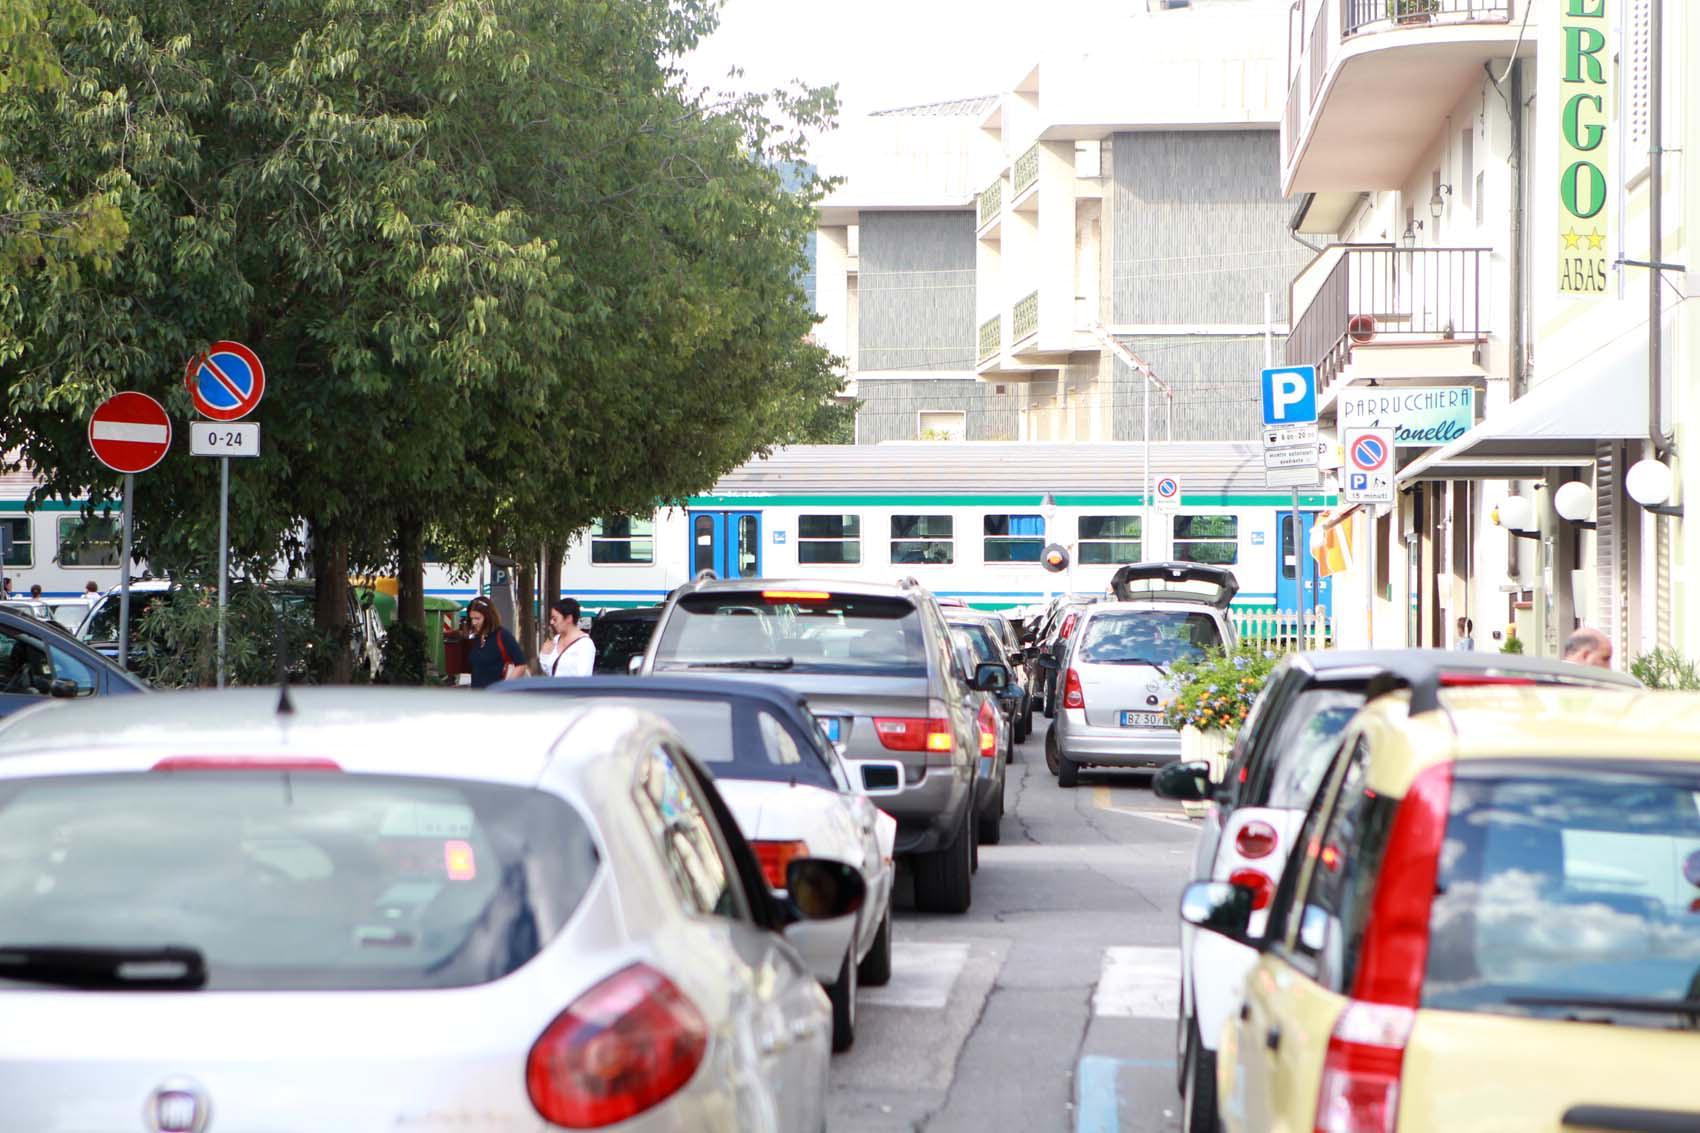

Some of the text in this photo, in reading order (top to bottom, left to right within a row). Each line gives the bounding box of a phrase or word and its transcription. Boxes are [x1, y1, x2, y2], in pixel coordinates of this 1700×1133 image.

[1560, 258, 1607, 292] ABAS
[1271, 372, 1308, 420] P
[1344, 388, 1470, 418] PARRUCCHIERA
[208, 431, 243, 447] 0-24
[1353, 475, 1365, 489] P
[496, 570, 506, 583] P
